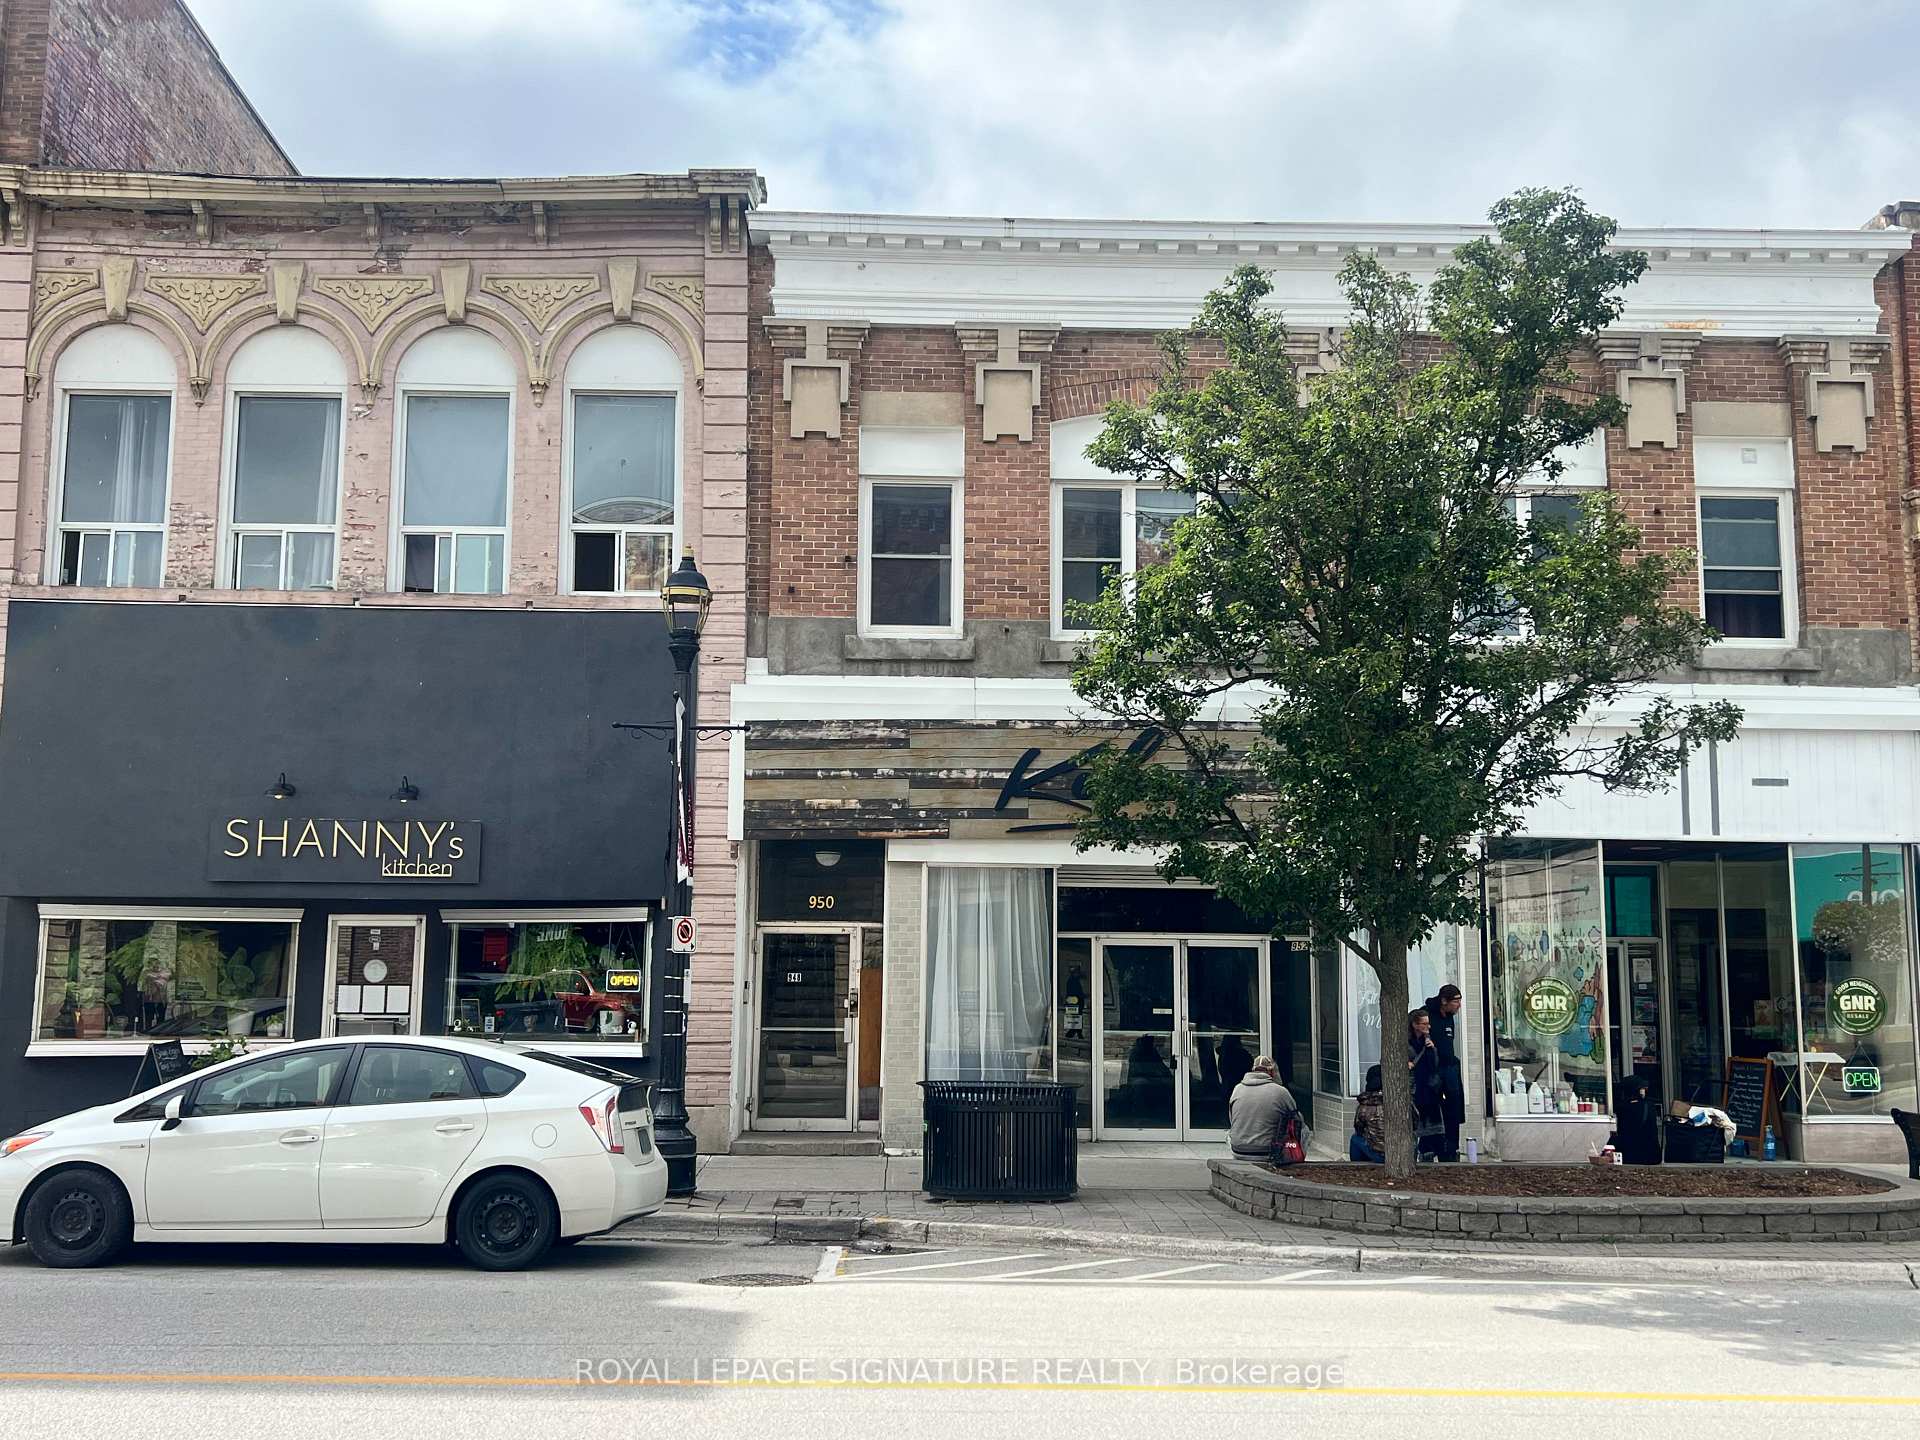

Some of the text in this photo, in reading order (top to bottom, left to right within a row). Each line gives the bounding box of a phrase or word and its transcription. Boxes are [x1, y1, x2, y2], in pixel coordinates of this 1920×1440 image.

[223, 818, 464, 859] SHANNY's
[382, 853, 453, 877] kitchen
[808, 895, 835, 909] 950
[610, 976, 639, 991] OPEN
[1530, 994, 1568, 1011] GNR
[1840, 994, 1876, 1012] GNR
[1845, 1072, 1879, 1088] OPEN
